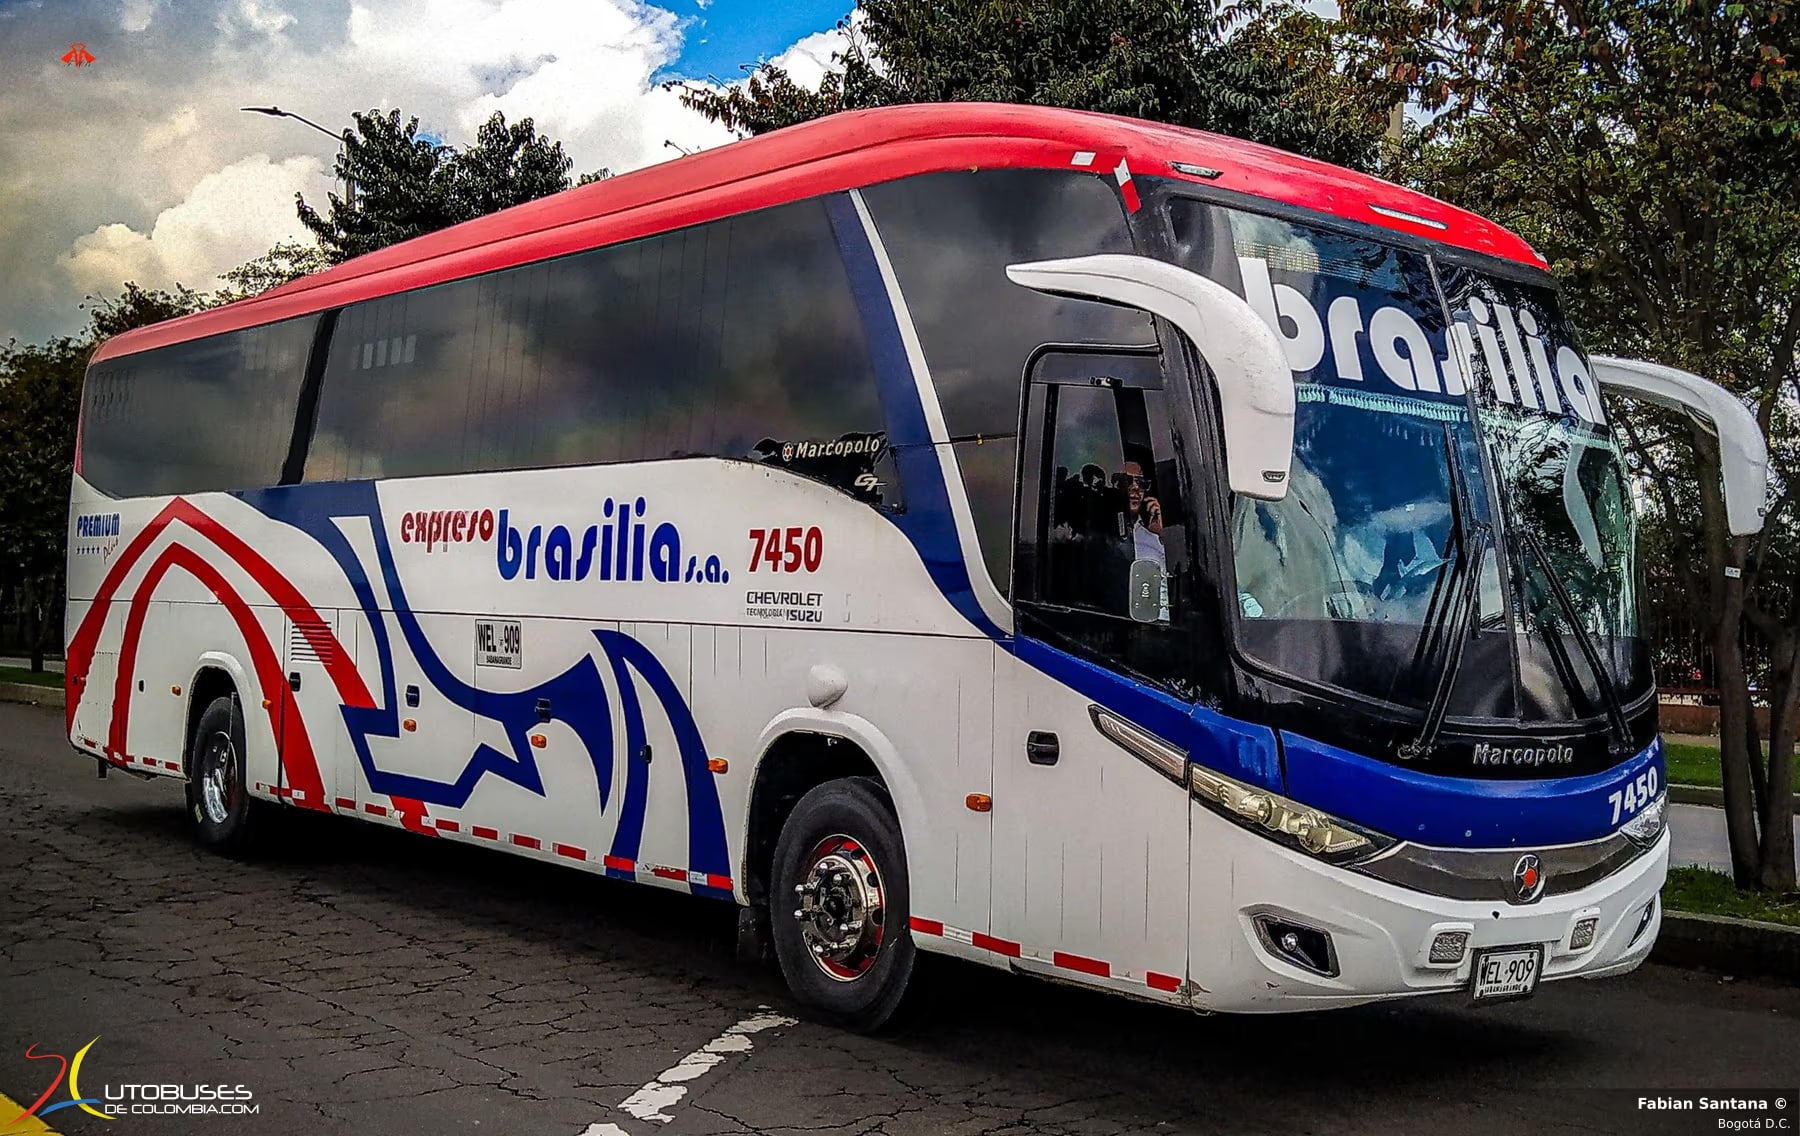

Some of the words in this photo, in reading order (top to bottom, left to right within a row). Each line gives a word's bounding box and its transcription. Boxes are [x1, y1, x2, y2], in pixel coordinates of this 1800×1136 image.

[1238, 257, 1608, 425] brasilia
[795, 435, 880, 459] Marcopolo
[77, 513, 120, 537] PREMIUM
[401, 509, 494, 553] expreso
[498, 497, 681, 582] brasilia
[748, 526, 823, 573] 7450
[746, 591, 823, 607] CHEVROLET
[786, 609, 823, 622] ISUZU
[477, 624, 497, 652] WEL
[504, 624, 520, 654] 909
[1473, 743, 1574, 766] Marcopolo
[1608, 766, 1658, 826] 7450
[1480, 961, 1502, 986] WEL
[1507, 959, 1535, 983] 909
